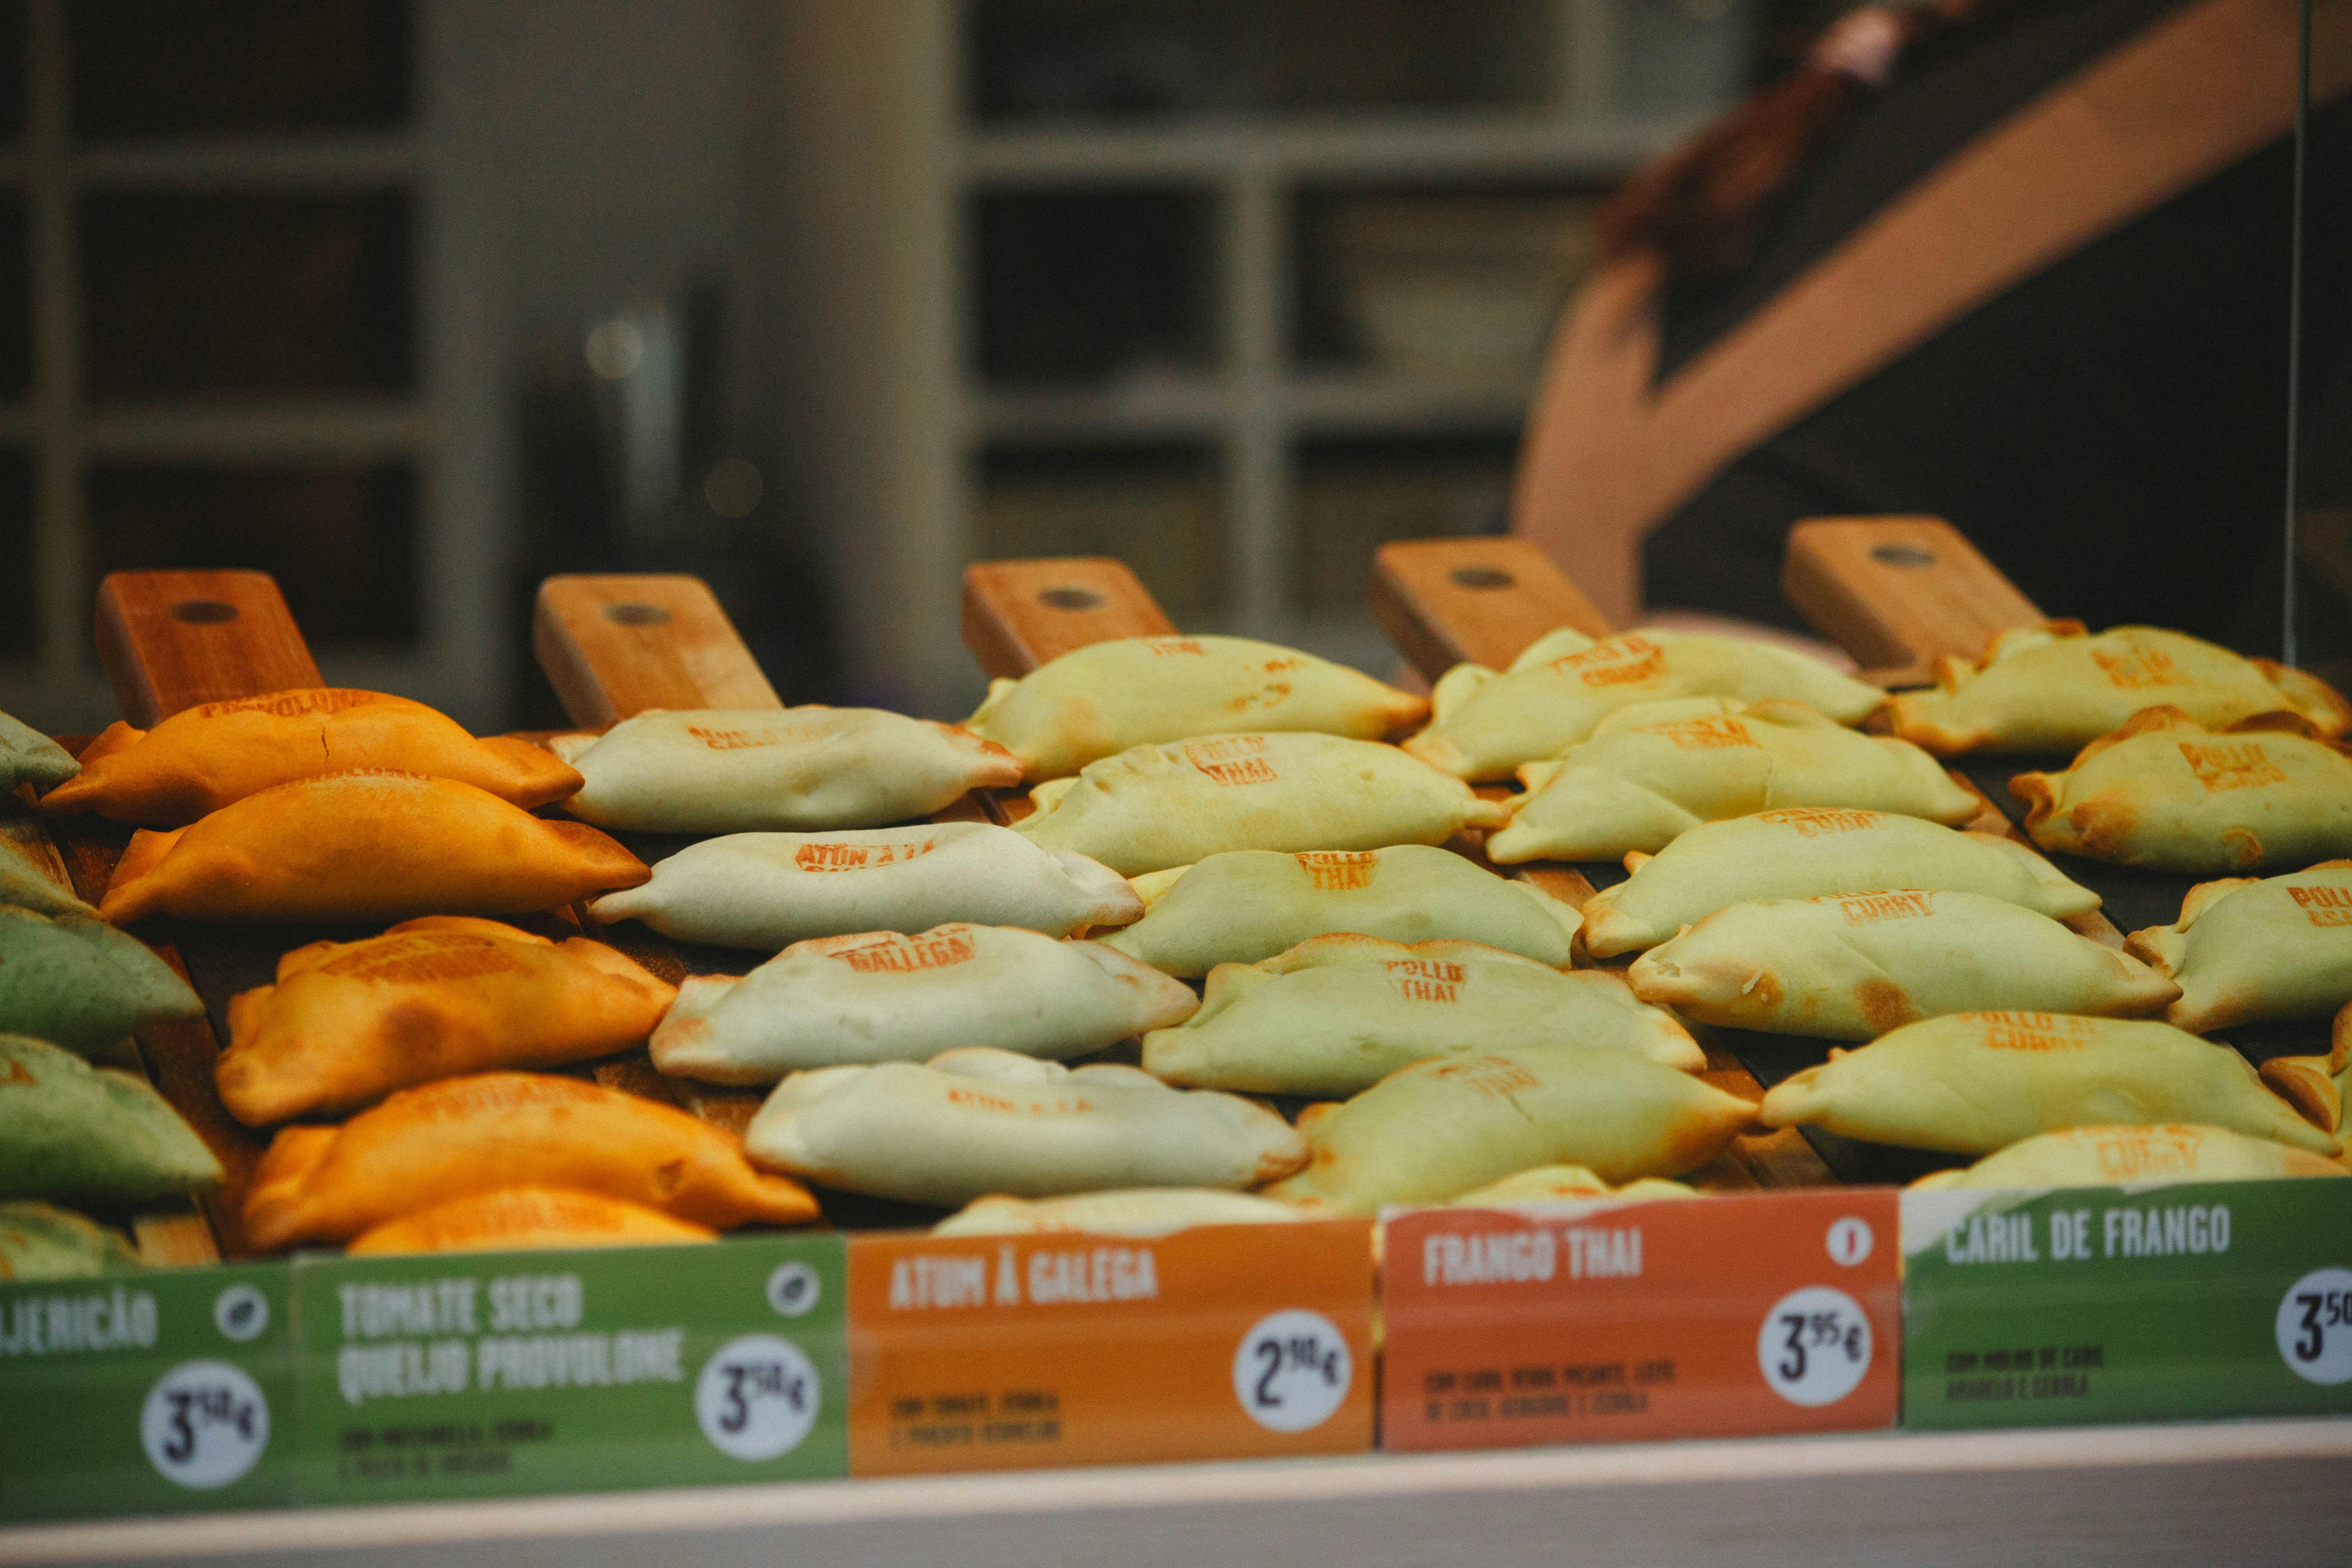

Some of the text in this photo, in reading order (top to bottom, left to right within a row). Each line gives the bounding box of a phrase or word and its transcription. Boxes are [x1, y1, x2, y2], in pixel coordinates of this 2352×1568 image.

[1308, 864, 1369, 890] THAI
[1841, 894, 1933, 926] CURRY
[1400, 979, 1457, 1003] THAI
[1424, 1227, 1642, 1286] FRANGO THAI
[1945, 1206, 2232, 1264] CARIL DE FRANGO
[1027, 1247, 1159, 1304] GALEGA
[338, 1274, 583, 1338] TOMATE SECO
[337, 1326, 685, 1407] QUEIJO PROVOLONE
